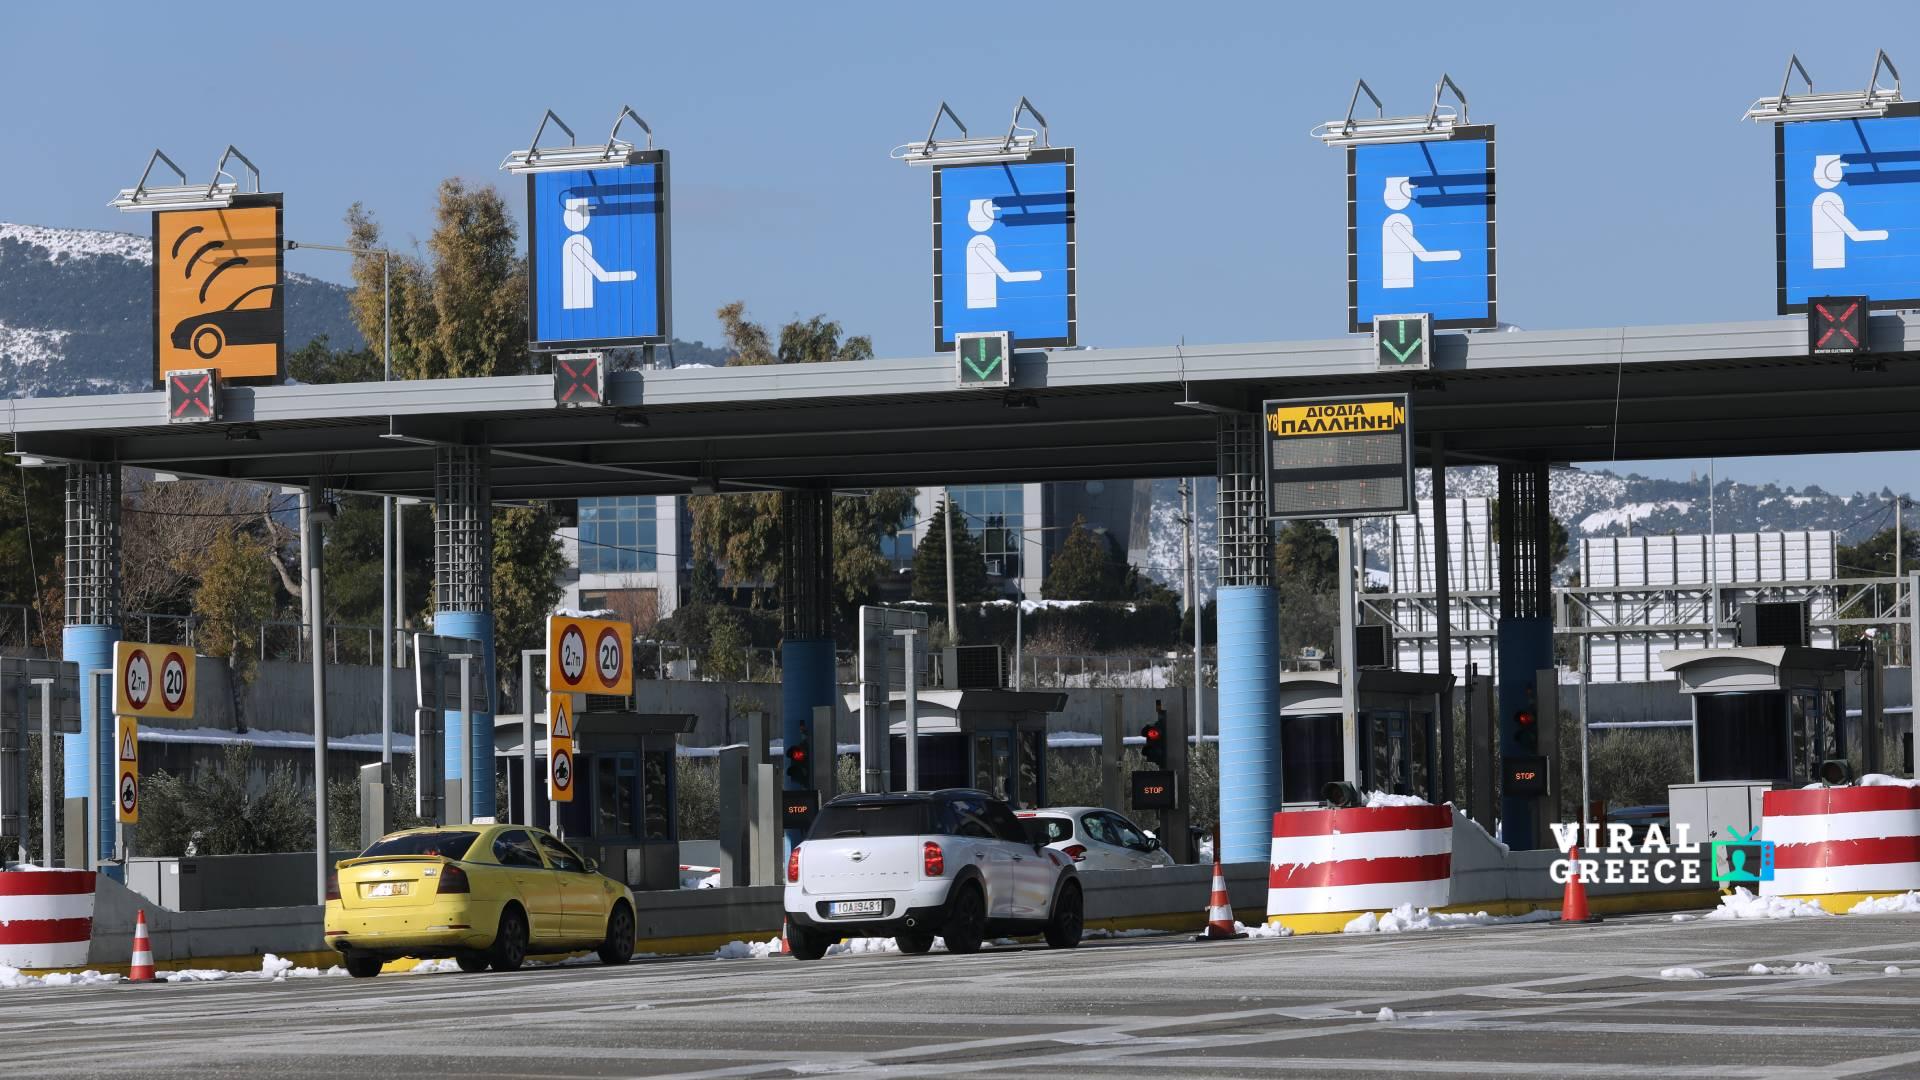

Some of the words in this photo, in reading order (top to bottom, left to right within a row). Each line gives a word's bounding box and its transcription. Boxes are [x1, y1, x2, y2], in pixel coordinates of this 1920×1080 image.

[1306, 404, 1365, 418] ΔΙΟΔΙΑ
[1281, 414, 1392, 434] ΠΑΛΛΗΝΗ
[602, 644, 618, 670] 20
[166, 669, 182, 695] 20
[1515, 772, 1535, 780] STOP
[1144, 786, 1164, 794] STOP
